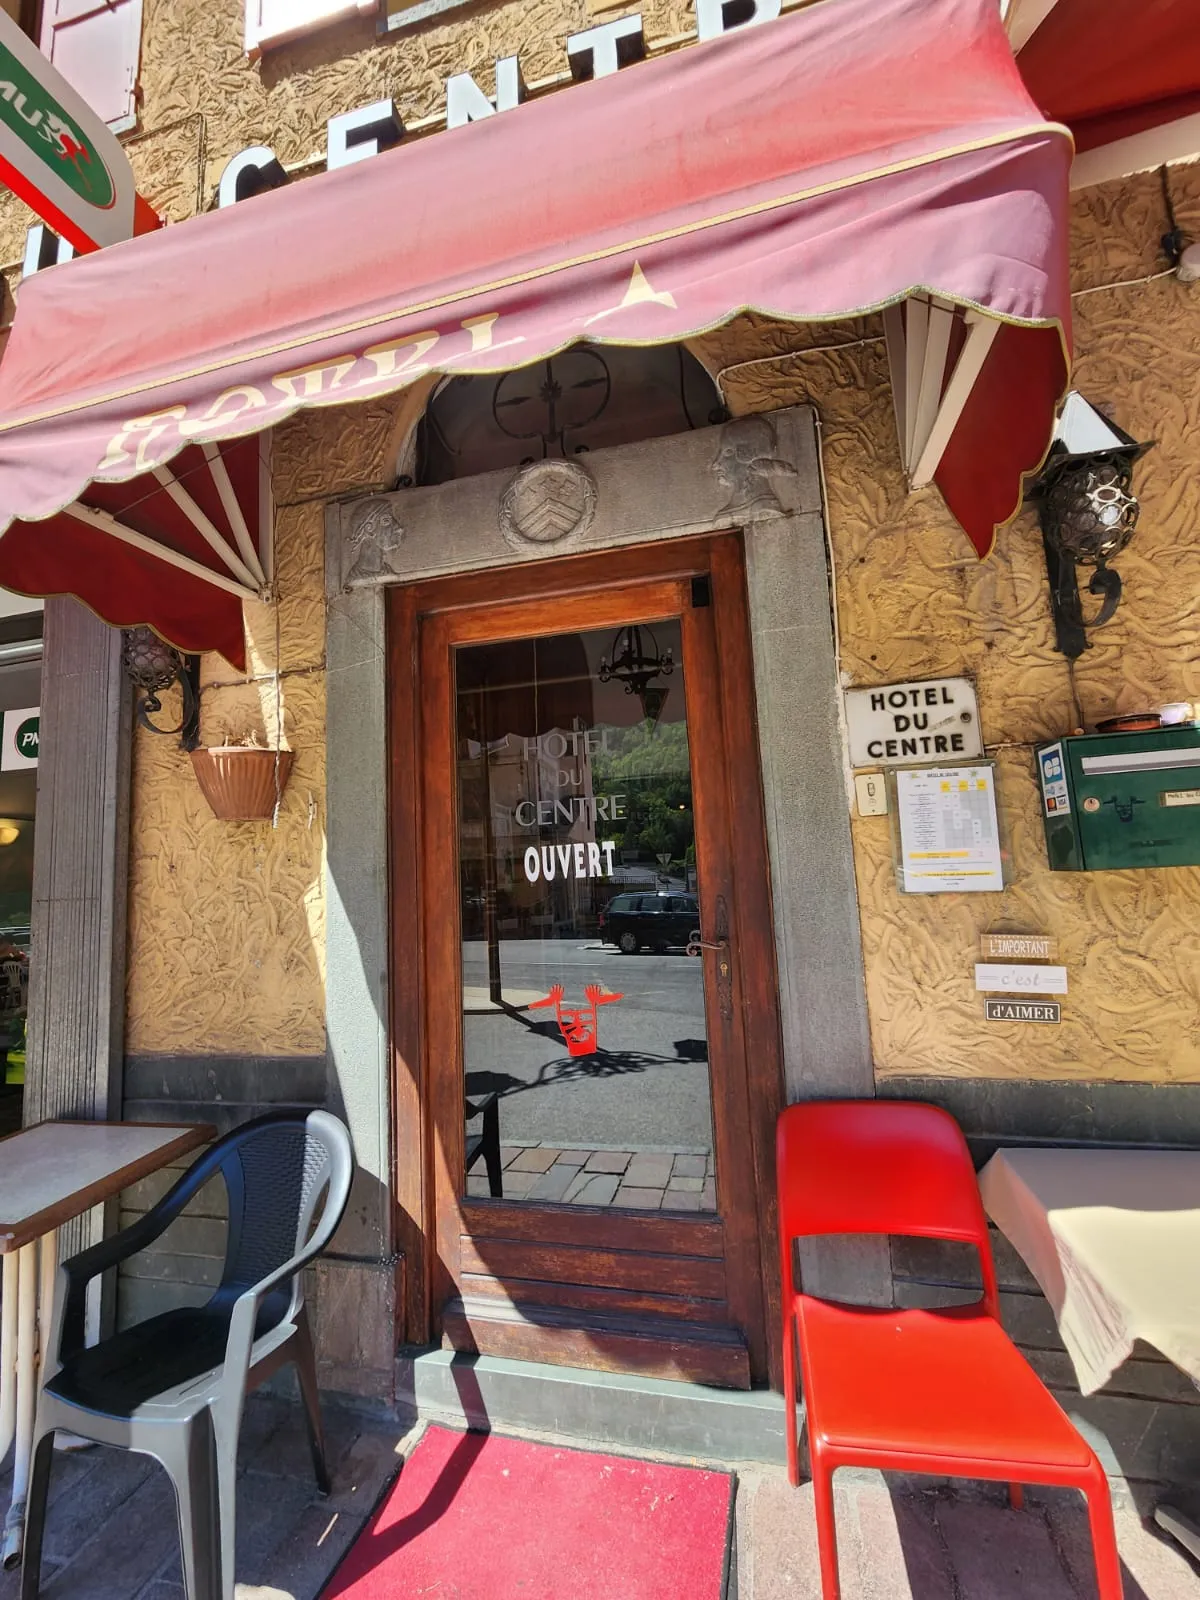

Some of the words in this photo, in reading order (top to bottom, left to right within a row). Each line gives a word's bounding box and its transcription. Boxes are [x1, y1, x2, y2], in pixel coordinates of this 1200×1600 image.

[870, 687, 955, 711] HOTEL
[894, 712, 928, 732] DU
[523, 730, 614, 760] HOTEL
[867, 734, 964, 758] CENTRE
[556, 769, 583, 787] DU
[515, 794, 628, 827] CENTRE
[524, 841, 615, 883] OUVERT
[989, 939, 1050, 955] L'IMPORTANT
[1001, 969, 1041, 987] c'est
[992, 1004, 1055, 1020] d'AIMER
